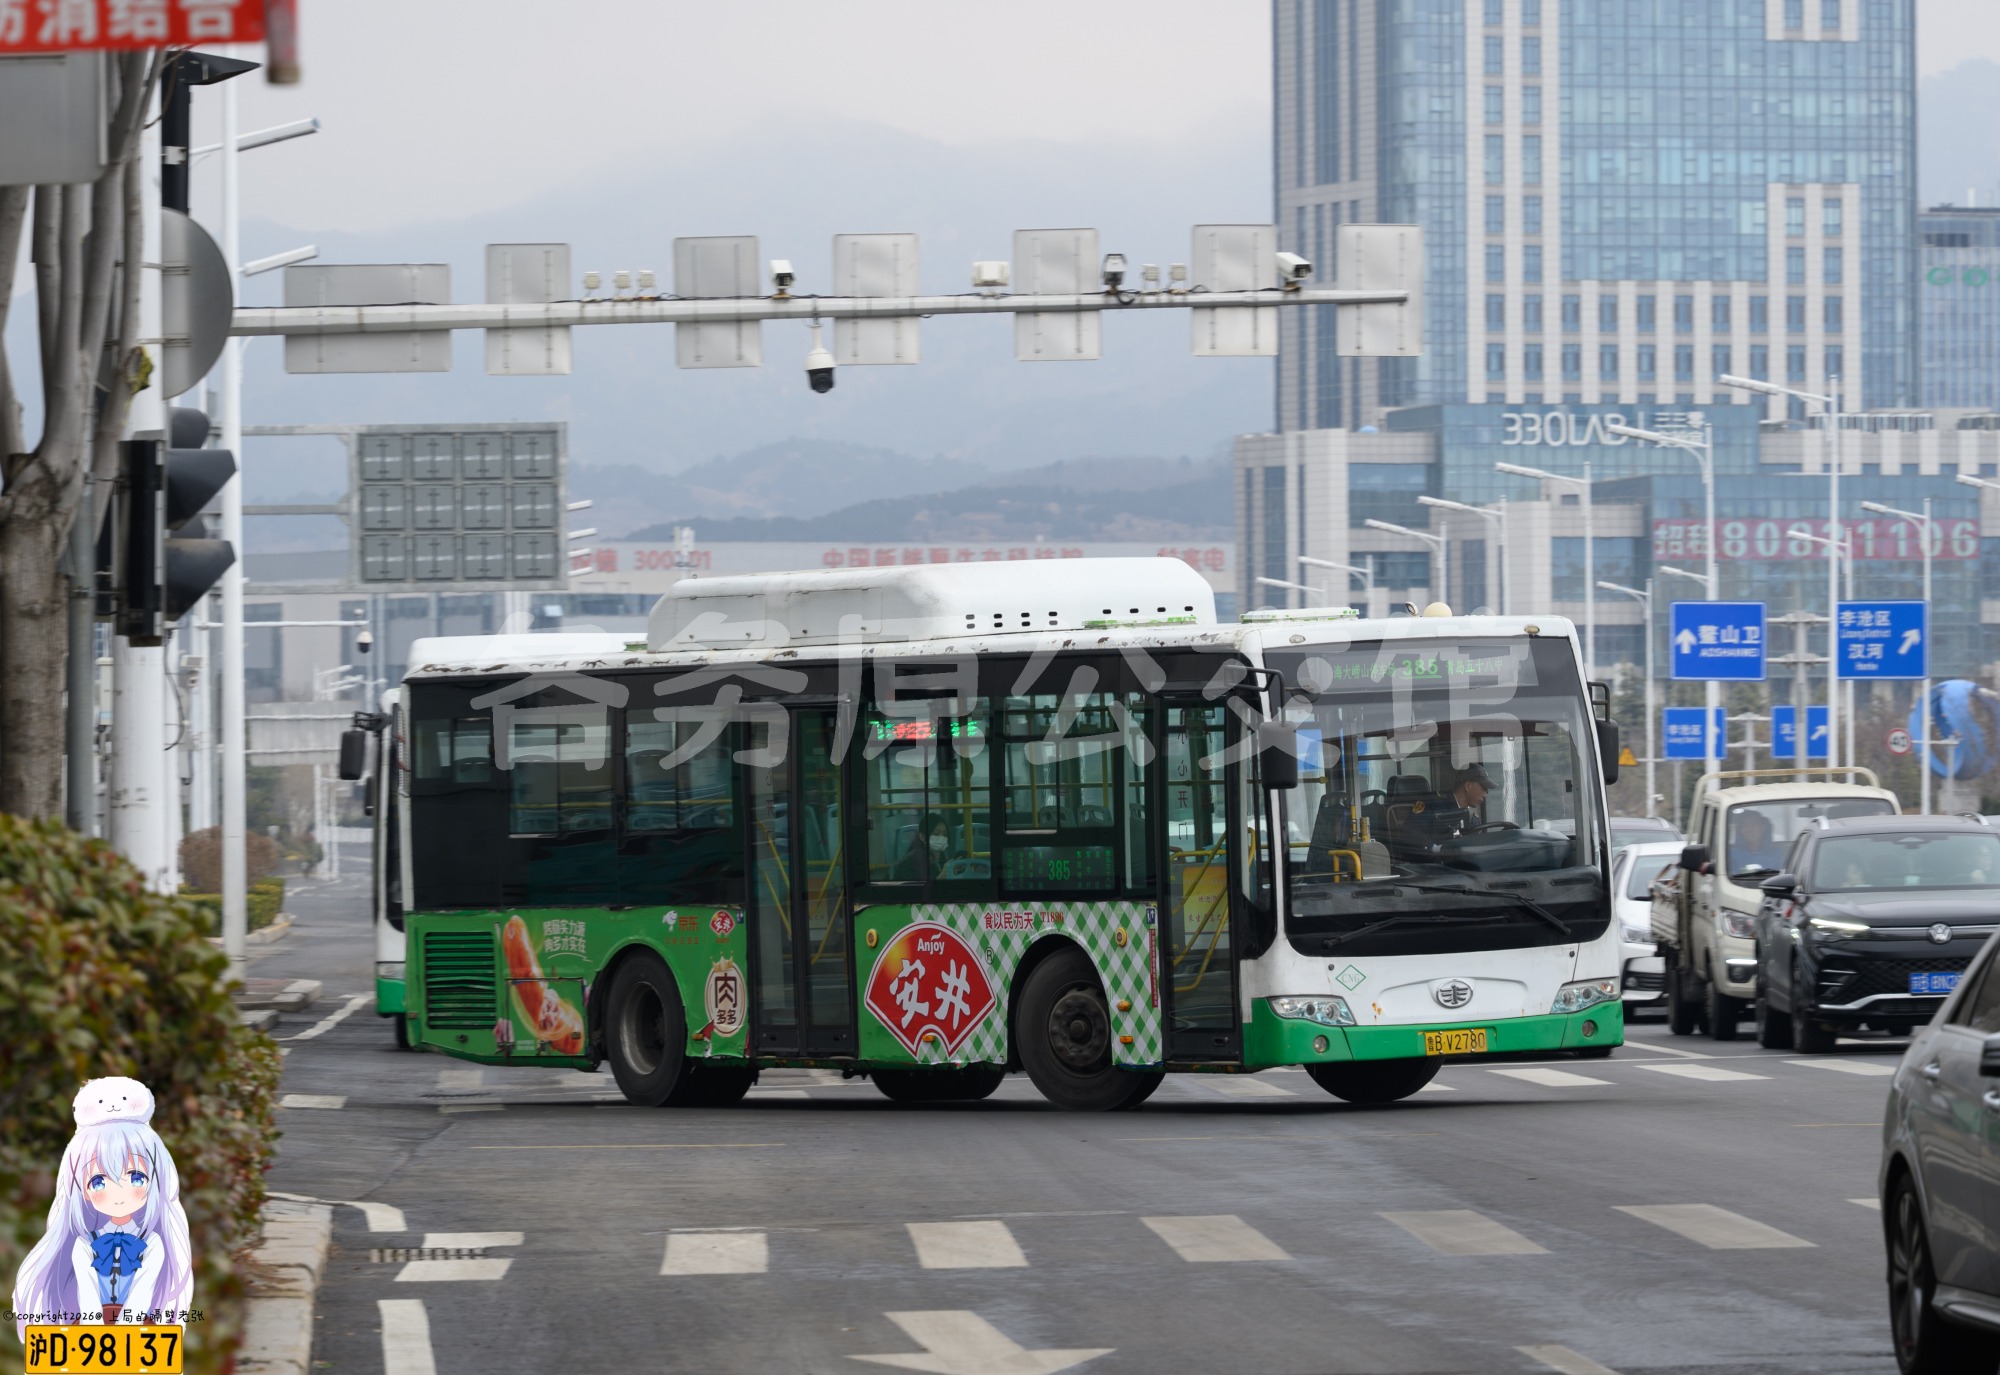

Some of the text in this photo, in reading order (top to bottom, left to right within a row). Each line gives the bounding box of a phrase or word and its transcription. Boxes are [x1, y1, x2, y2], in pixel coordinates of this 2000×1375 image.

[634, 550, 713, 571] 30001
[1840, 610, 1892, 626] 李沧区
[1402, 658, 1438, 677] 385
[1048, 860, 1071, 880] 385
[679, 916, 699, 932] 京东
[984, 911, 1034, 930] 食以民为天
[917, 935, 945, 956] Anjoy
[1341, 973, 1360, 984] CNG
[890, 959, 970, 1030] 安井
